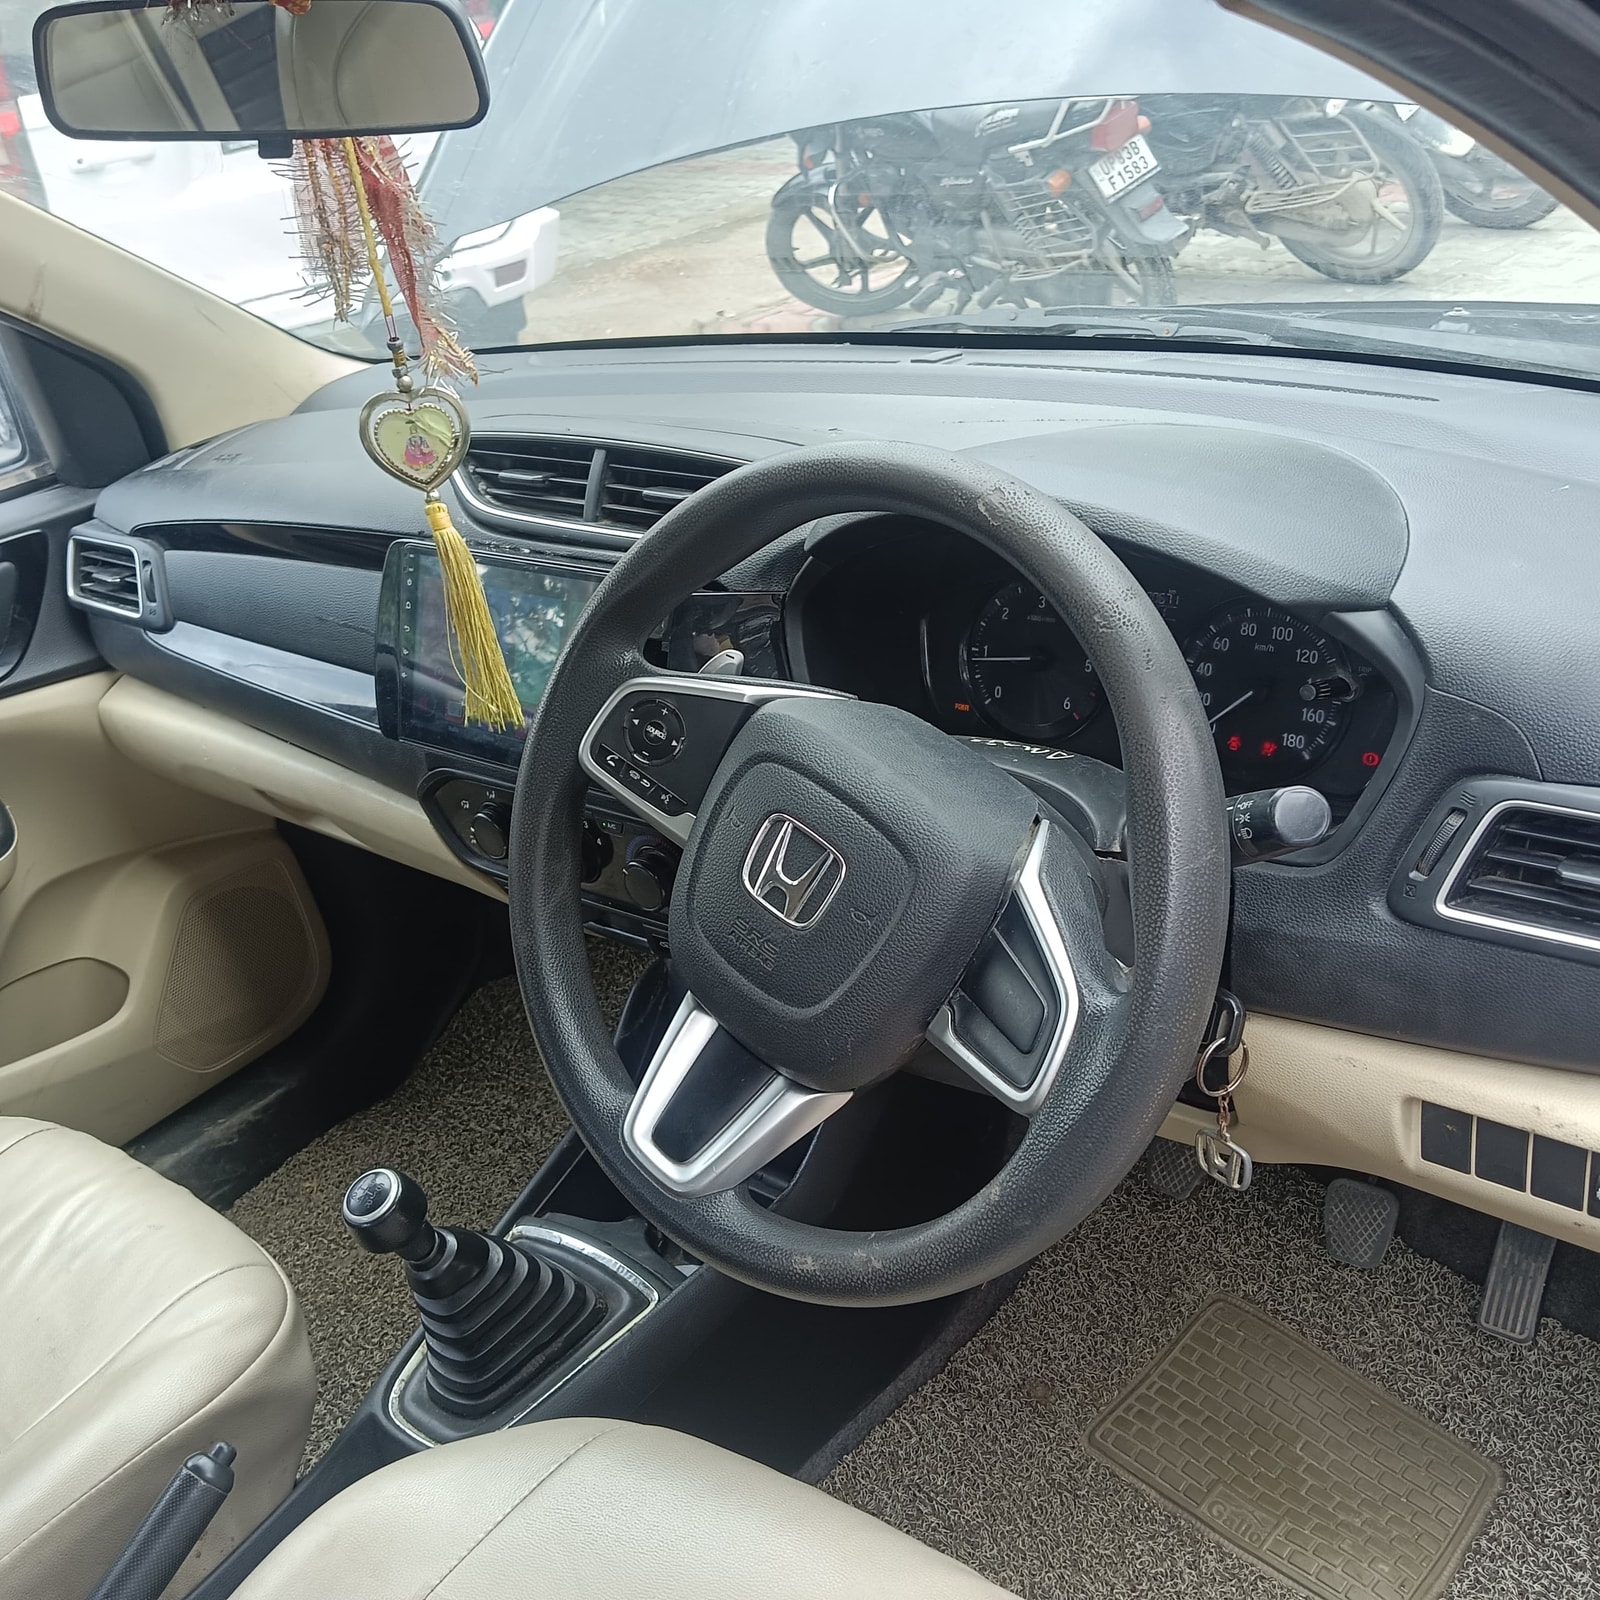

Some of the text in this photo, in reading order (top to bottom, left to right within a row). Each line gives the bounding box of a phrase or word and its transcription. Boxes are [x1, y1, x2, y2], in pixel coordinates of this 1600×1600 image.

[1108, 156, 1149, 191] F1583
[1038, 596, 1046, 609] 3
[1002, 607, 1009, 620] 2
[1240, 622, 1257, 637] 80
[1272, 626, 1294, 642] 100
[984, 645, 988, 656] 1
[1213, 637, 1229, 651] 60
[1254, 643, 1274, 652] km/h
[1296, 648, 1318, 664] 120
[1084, 660, 1092, 673] 5
[1196, 662, 1212, 676] 40
[994, 686, 1002, 698] 0
[1063, 697, 1071, 710] 6
[1302, 708, 1325, 724] 160
[646, 725, 667, 740] SOURCE
[1282, 733, 1304, 749] 180
[1240, 800, 1254, 810] OFF
[364, 1199, 373, 1209] R
